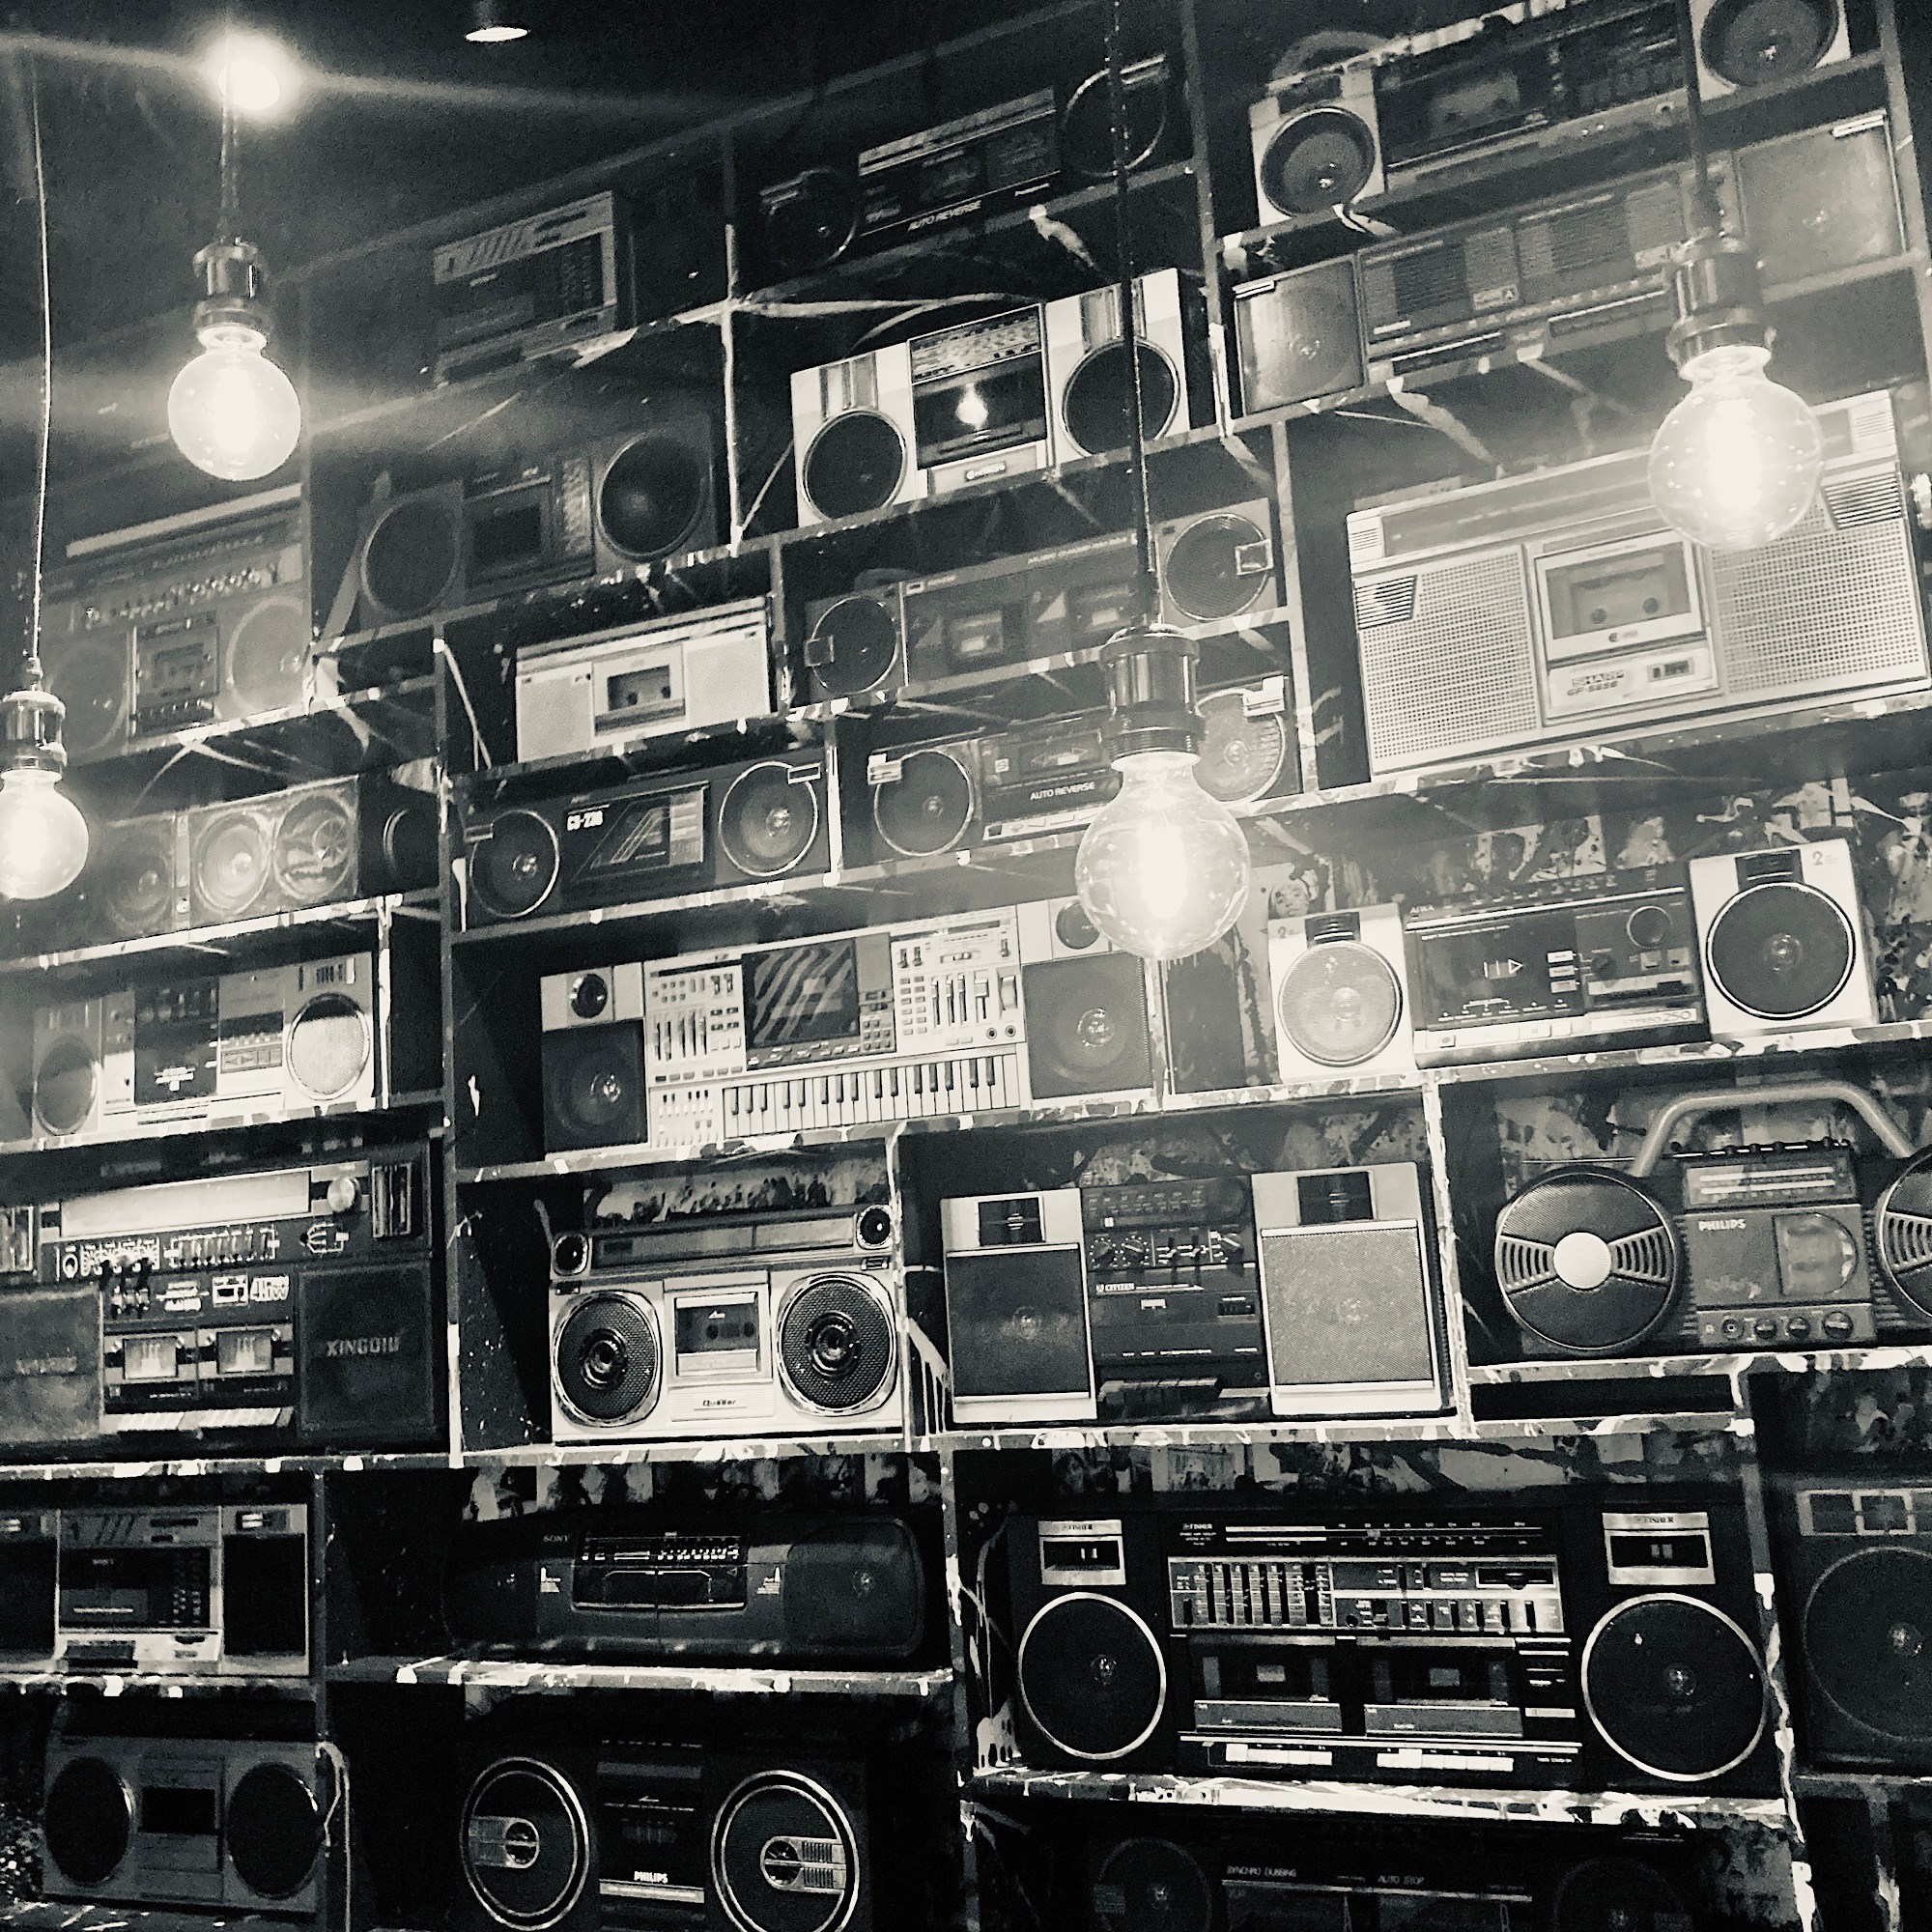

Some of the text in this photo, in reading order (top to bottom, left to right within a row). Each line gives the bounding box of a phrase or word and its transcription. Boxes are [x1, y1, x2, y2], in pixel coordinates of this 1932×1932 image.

[1030, 781, 1095, 802] AUTO REVERSE
[1812, 850, 1823, 867] 2
[1277, 925, 1287, 939] 2
[1662, 1009, 1692, 1023] 250
[1697, 1218, 1747, 1232] PHILIPS
[542, 1534, 569, 1544] SONY
[634, 1870, 668, 1885] PHILIPS
[1377, 1874, 1401, 1886] AUTO
